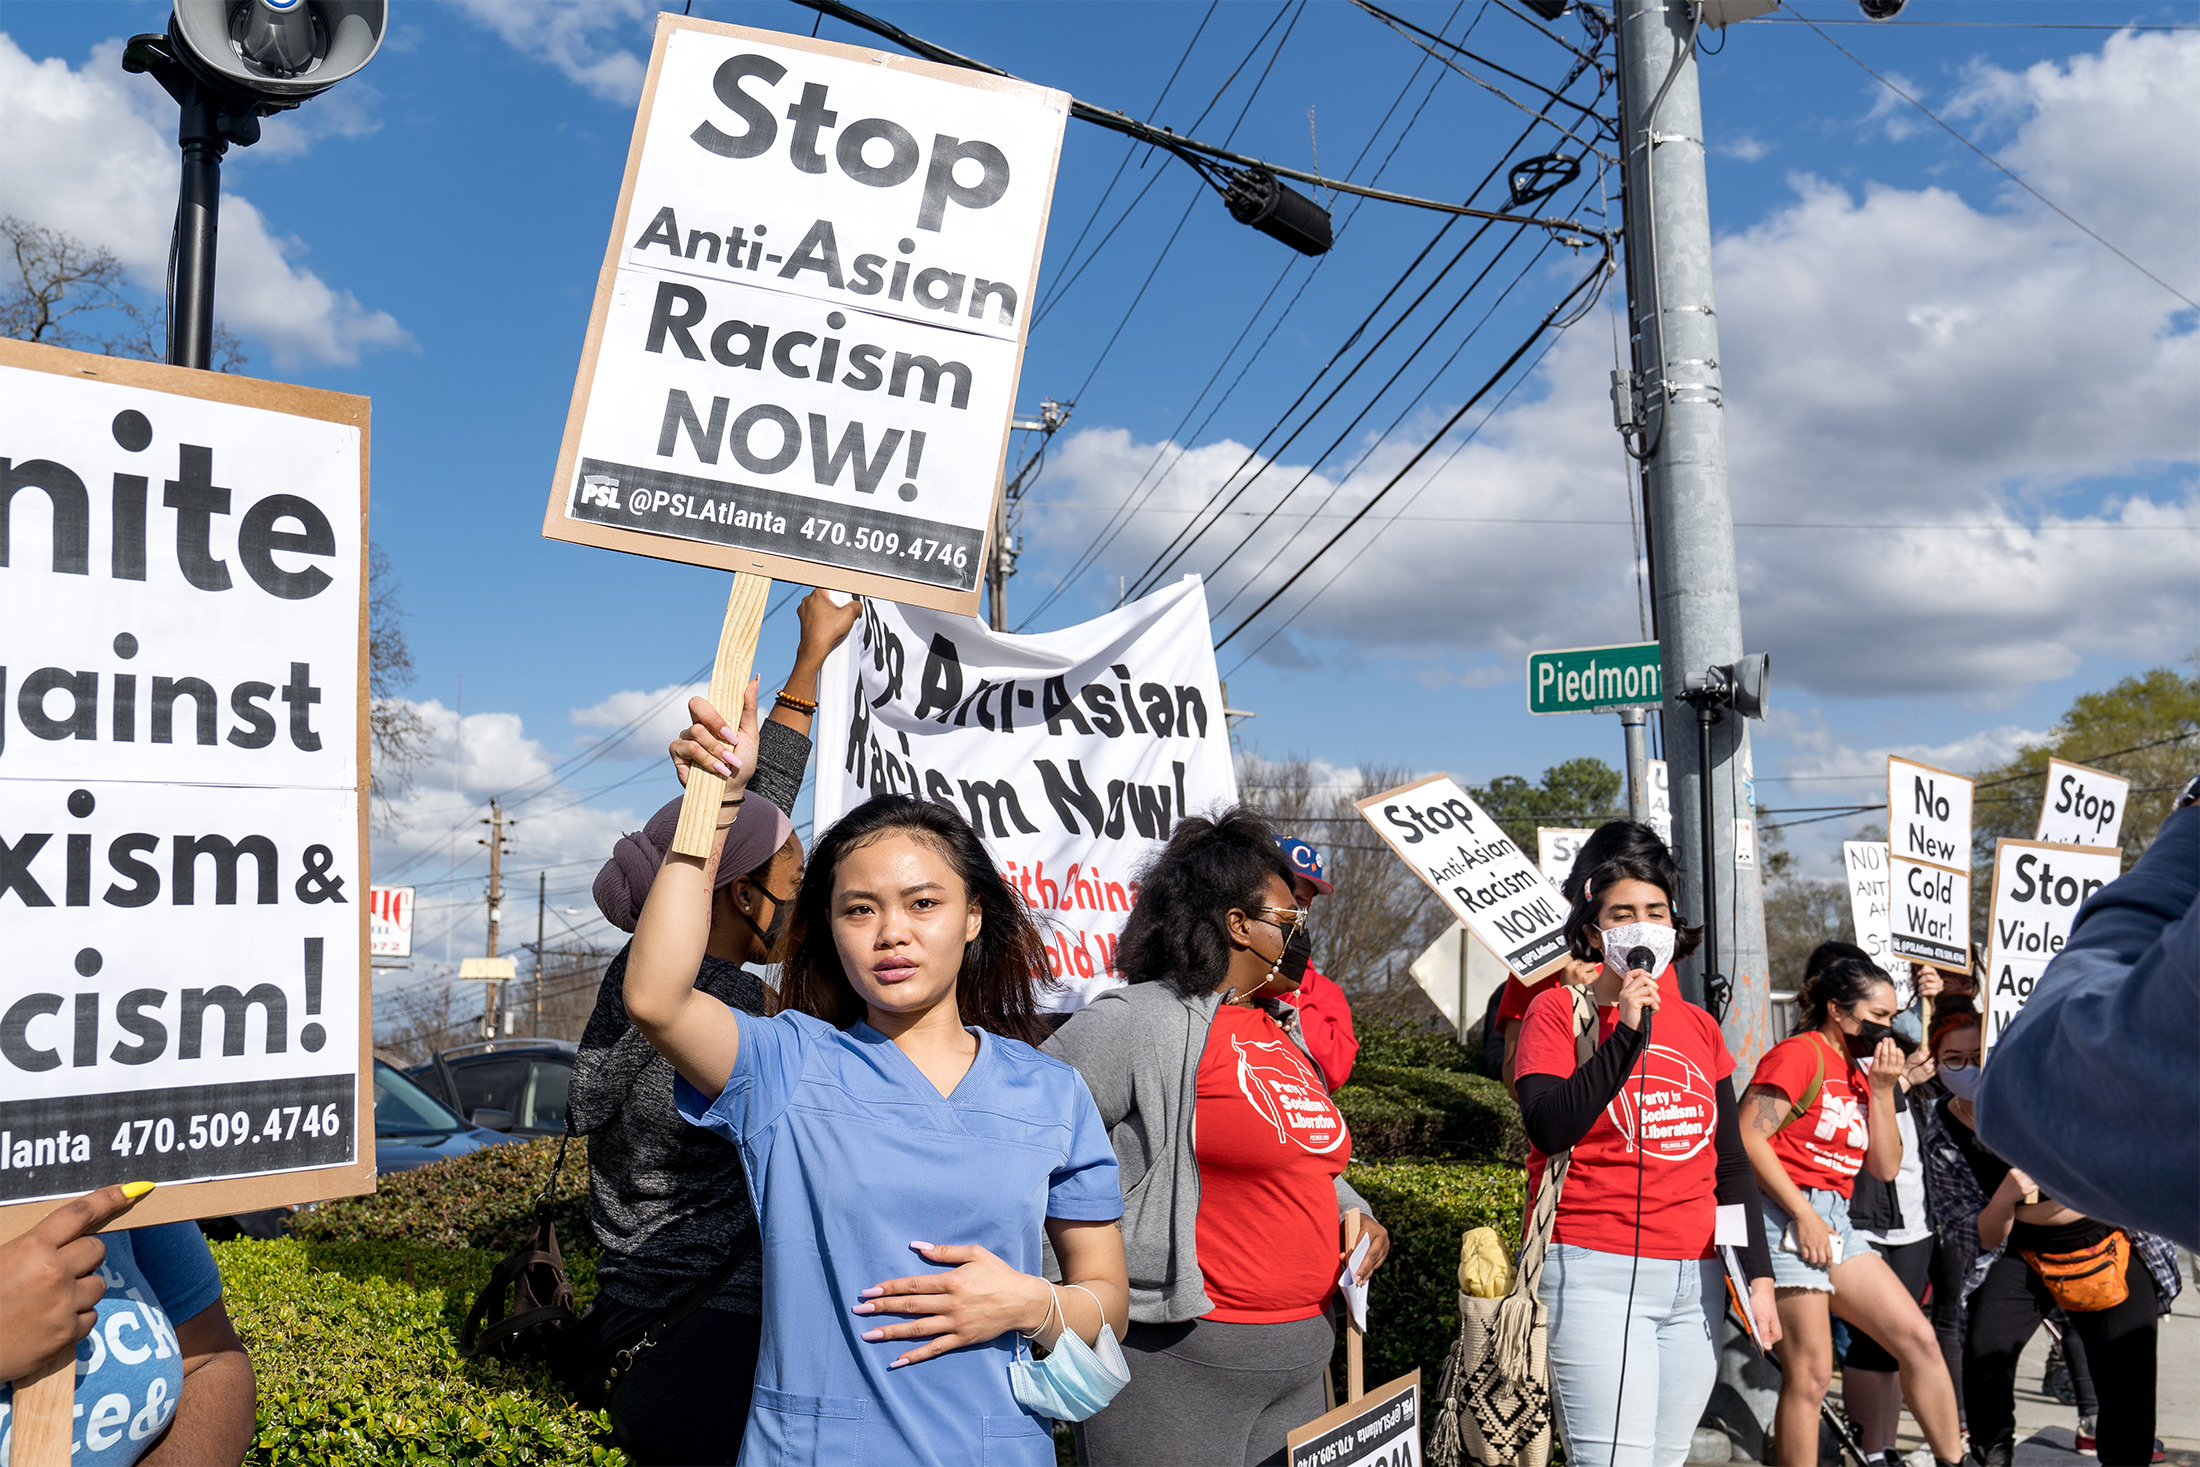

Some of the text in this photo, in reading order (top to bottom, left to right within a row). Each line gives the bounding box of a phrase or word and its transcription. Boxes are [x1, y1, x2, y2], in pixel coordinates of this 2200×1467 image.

[690, 54, 1010, 232] Stop
[634, 207, 1018, 327] Anti-Asian
[645, 281, 972, 410] Racism
[656, 388, 926, 502] NOW!
[581, 483, 967, 569] PSL @PSLAtlanta 470.509.4746
[852, 594, 904, 709] top
[1539, 659, 1662, 703] Piedmon
[1384, 799, 1475, 844] Stop
[1915, 775, 1949, 822] No
[2055, 775, 2115, 833] Stop
[1428, 839, 1516, 885] Anti-Asian
[1910, 823, 1955, 861] New
[295, 844, 349, 904] &
[1000, 860, 1058, 910] ith
[1453, 870, 1537, 913] Racism
[1908, 867, 1953, 904] Cold
[1493, 896, 1562, 943] NOW!
[1907, 904, 1952, 941] War!
[1998, 919, 2070, 954] Viole
[1030, 930, 1094, 979] old
[0, 937, 327, 1072] cism!
[1633, 1090, 1669, 1107] Party
[1641, 1104, 1697, 1124] Socialism
[1, 1102, 340, 1170] lanta 470.509.4746
[1641, 1121, 1702, 1139] Liberation
